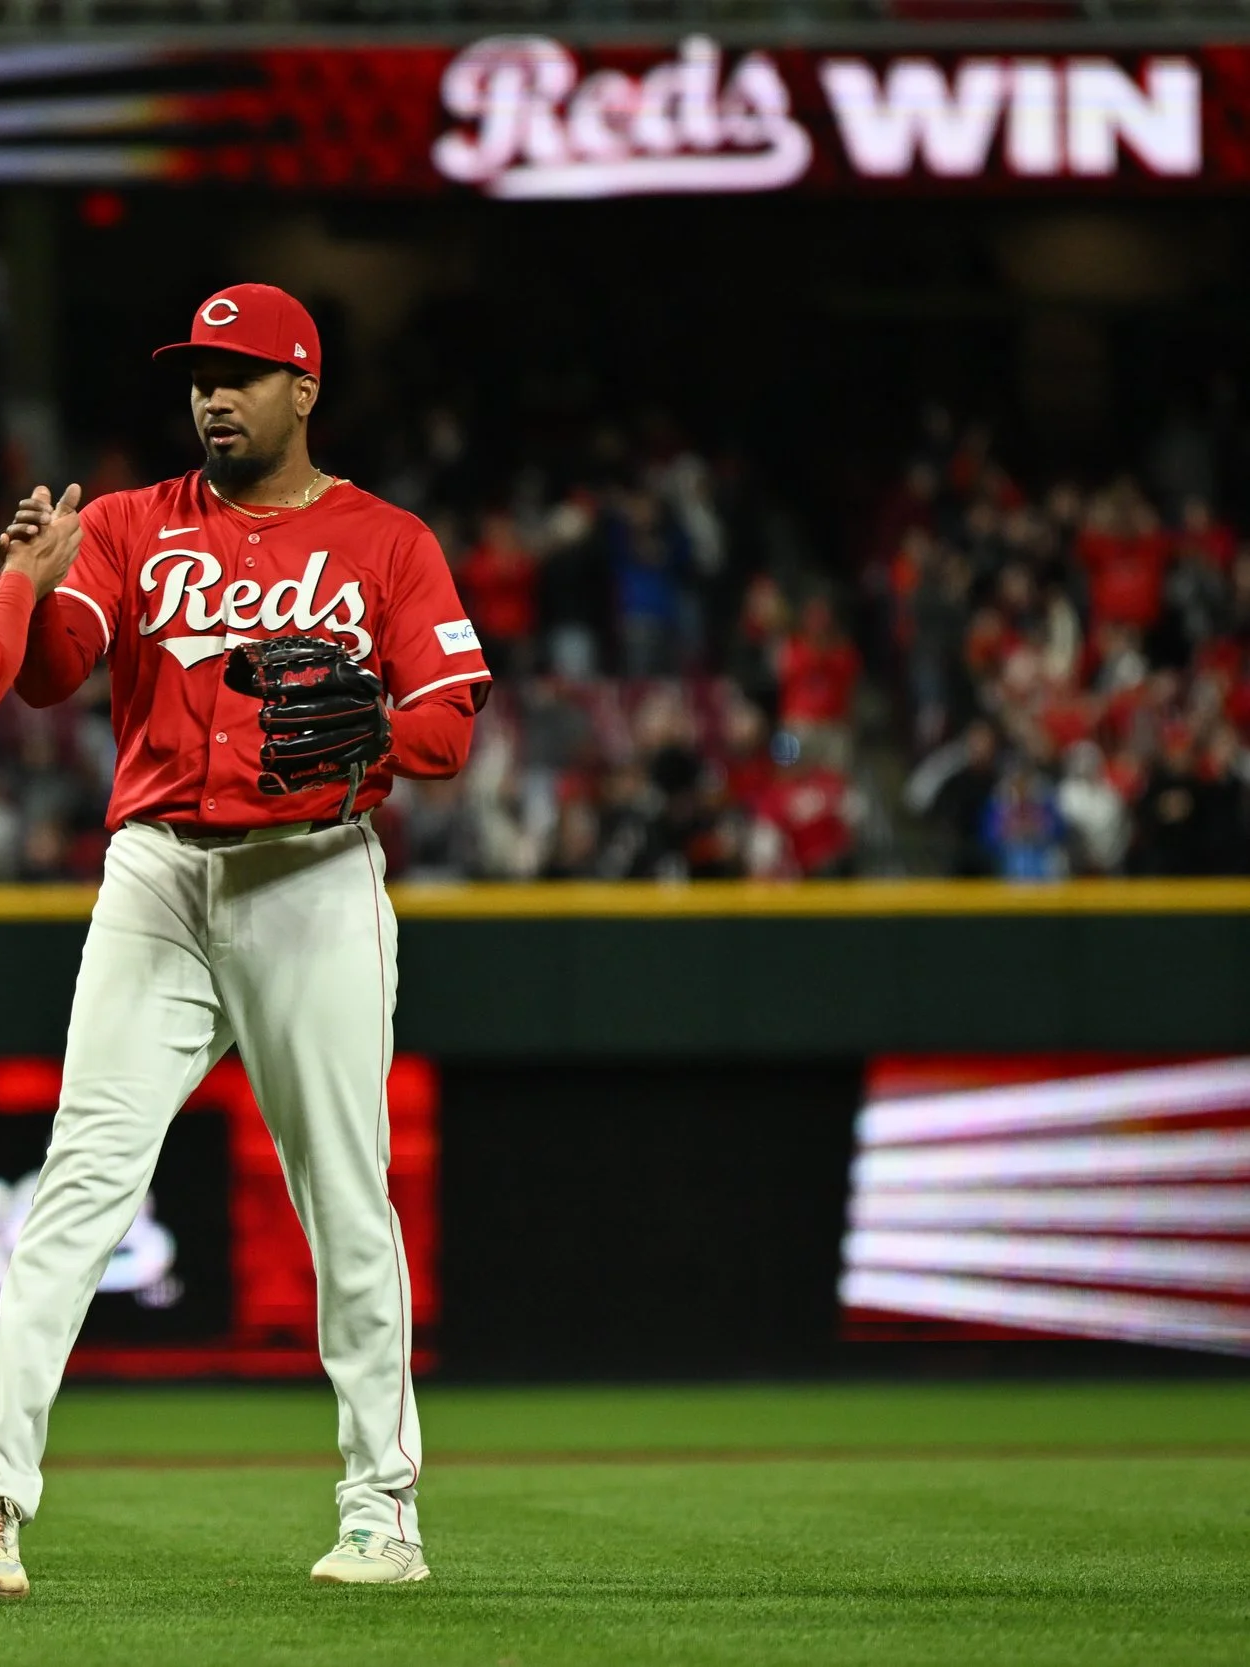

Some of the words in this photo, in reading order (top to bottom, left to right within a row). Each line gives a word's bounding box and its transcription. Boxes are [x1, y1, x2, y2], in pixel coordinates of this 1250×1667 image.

[433, 34, 812, 199] Reds
[820, 58, 1202, 176] WIN
[201, 298, 239, 326] C
[139, 548, 373, 669] Reds
